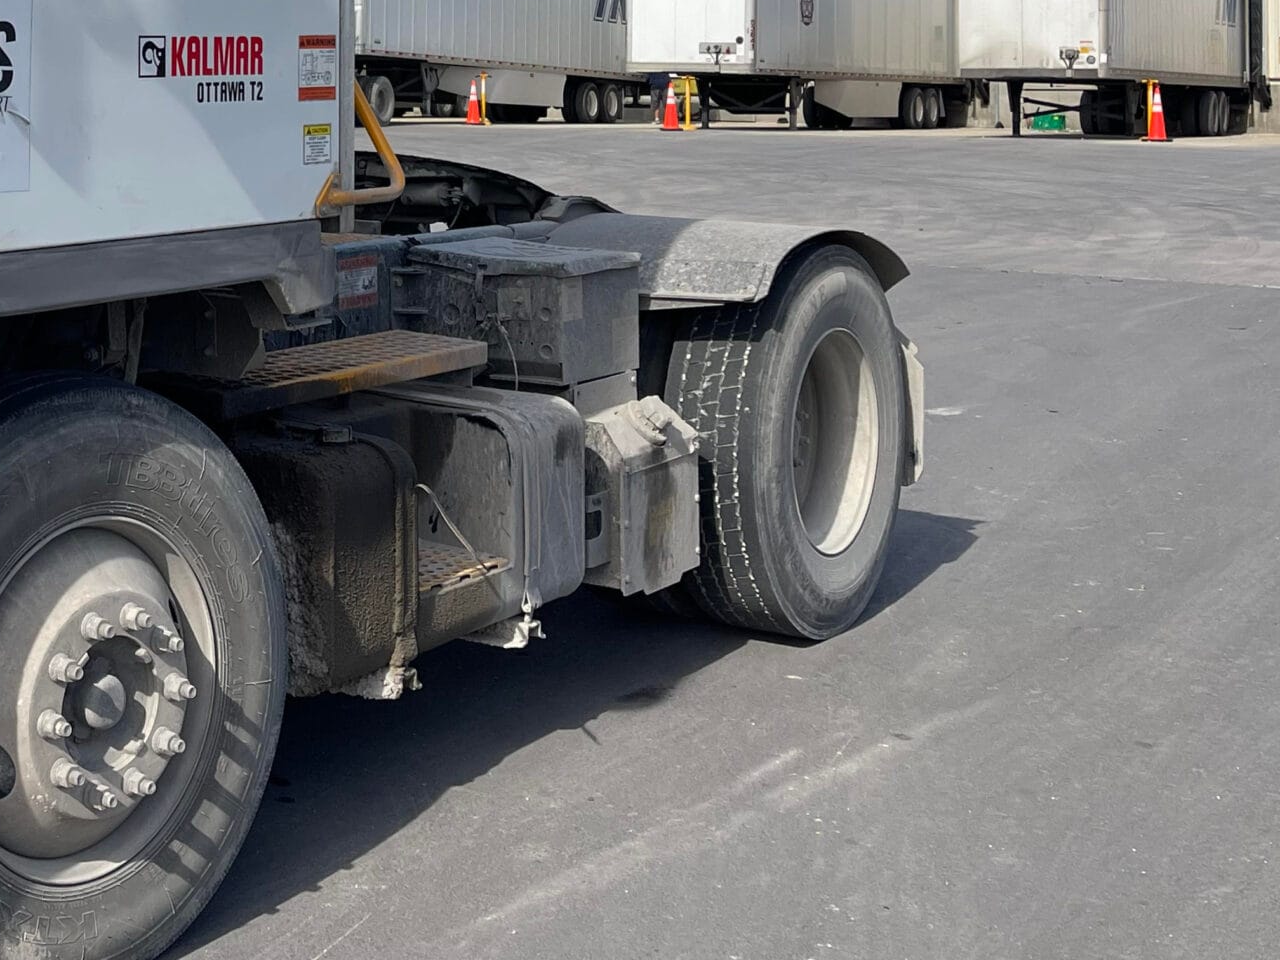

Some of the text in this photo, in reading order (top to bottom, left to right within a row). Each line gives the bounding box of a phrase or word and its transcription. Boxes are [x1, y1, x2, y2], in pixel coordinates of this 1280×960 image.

[171, 36, 263, 76] KALMAR
[197, 81, 263, 103] OTTAWA T2
